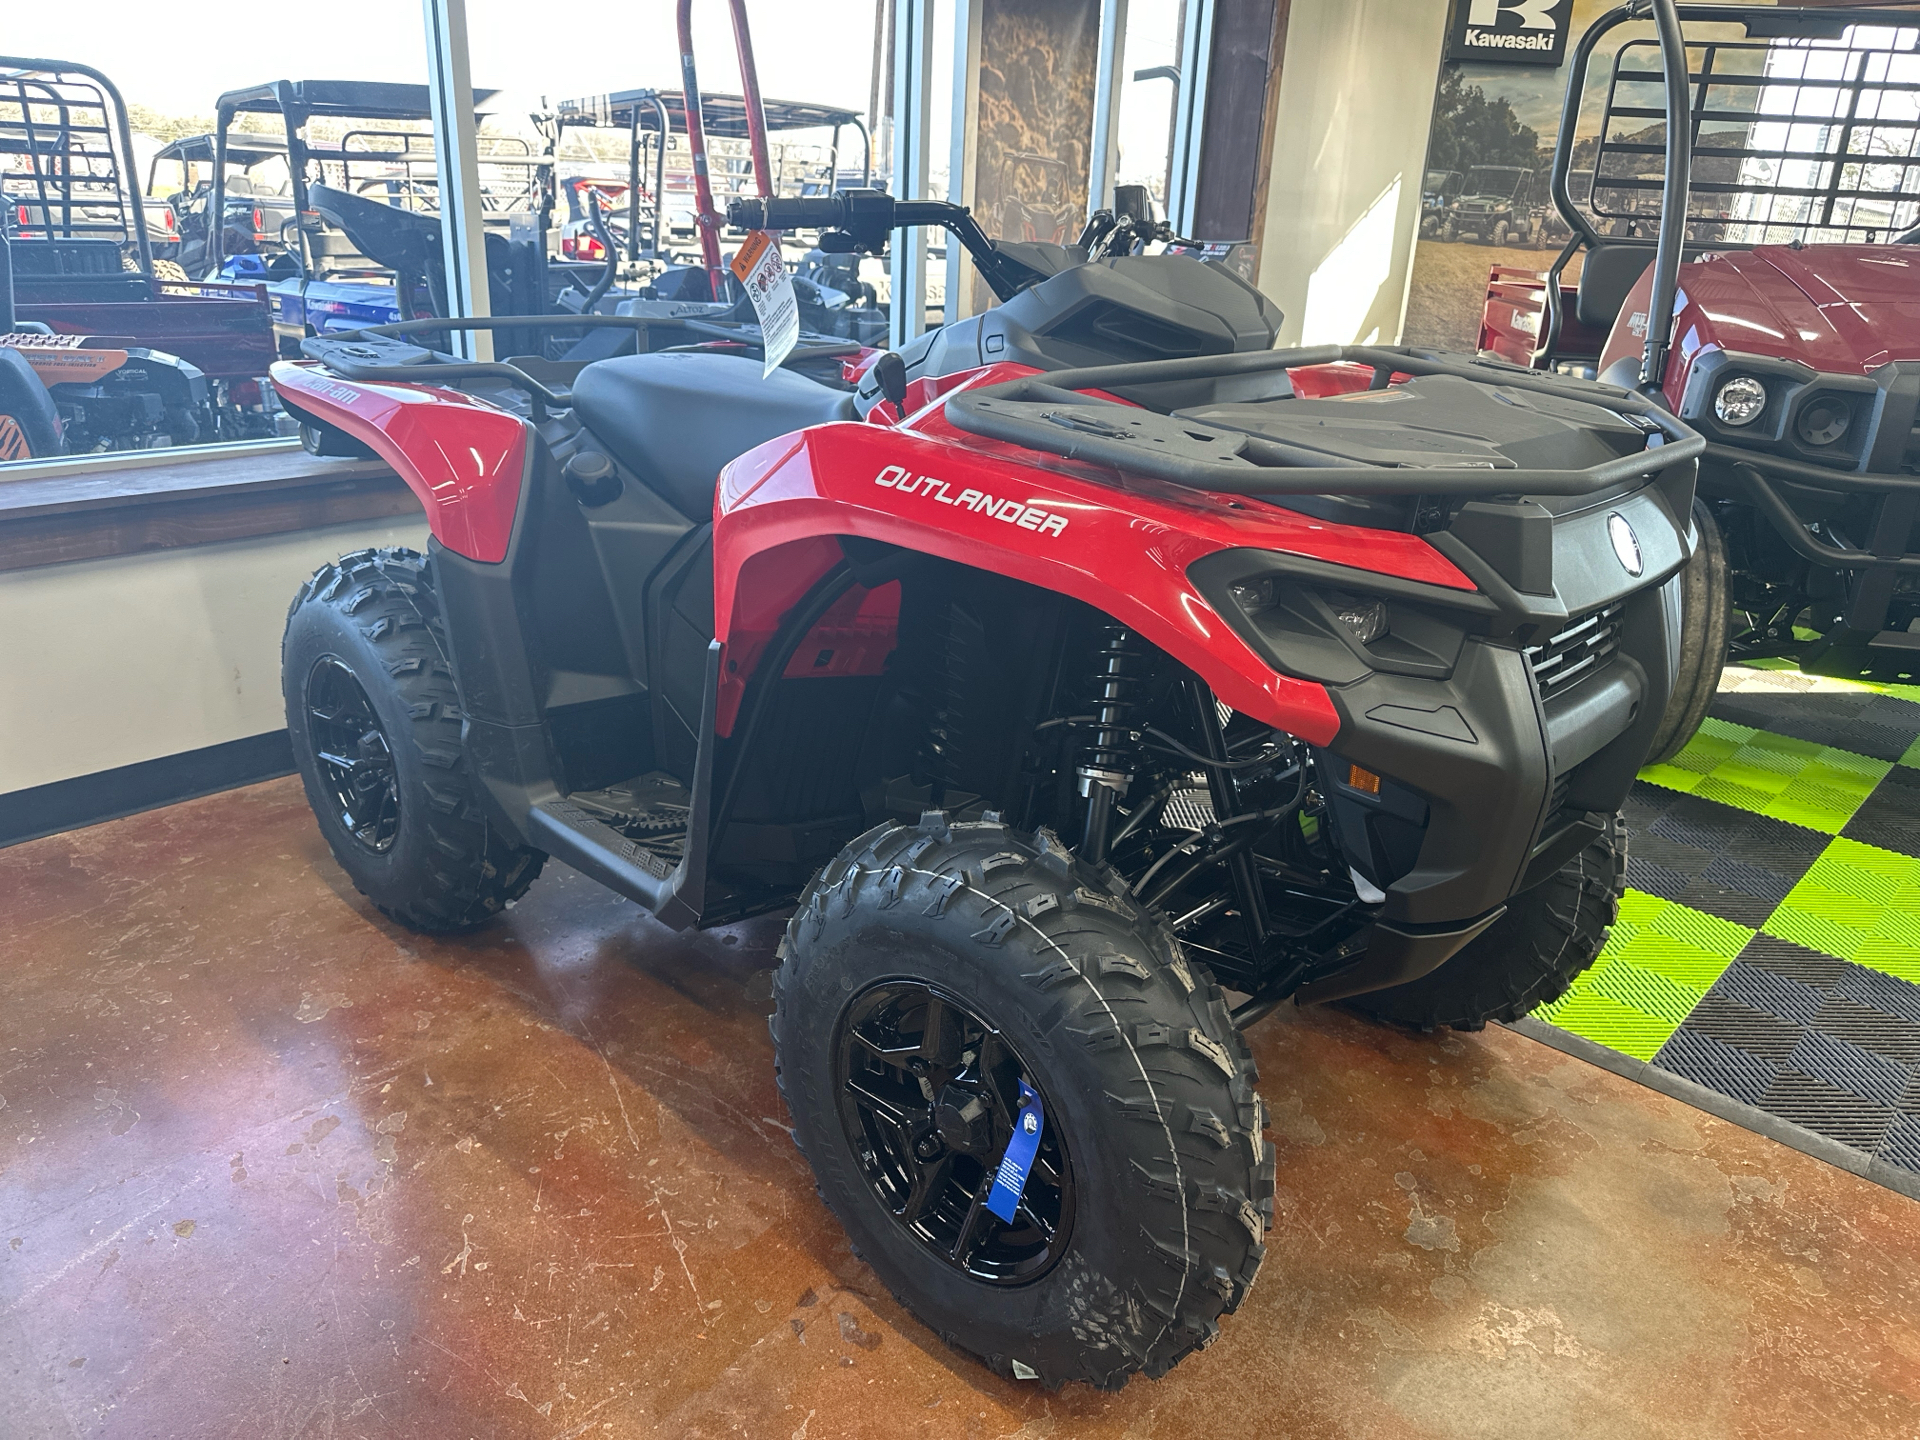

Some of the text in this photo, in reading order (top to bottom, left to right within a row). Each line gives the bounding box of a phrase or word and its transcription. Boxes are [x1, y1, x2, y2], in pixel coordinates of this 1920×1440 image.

[1464, 29, 1555, 51] Kawasaki
[743, 237, 762, 263] WARNING
[675, 304, 704, 316] ALTOZ
[302, 377, 361, 405] can-am
[875, 465, 1069, 538] OUTLANDER
